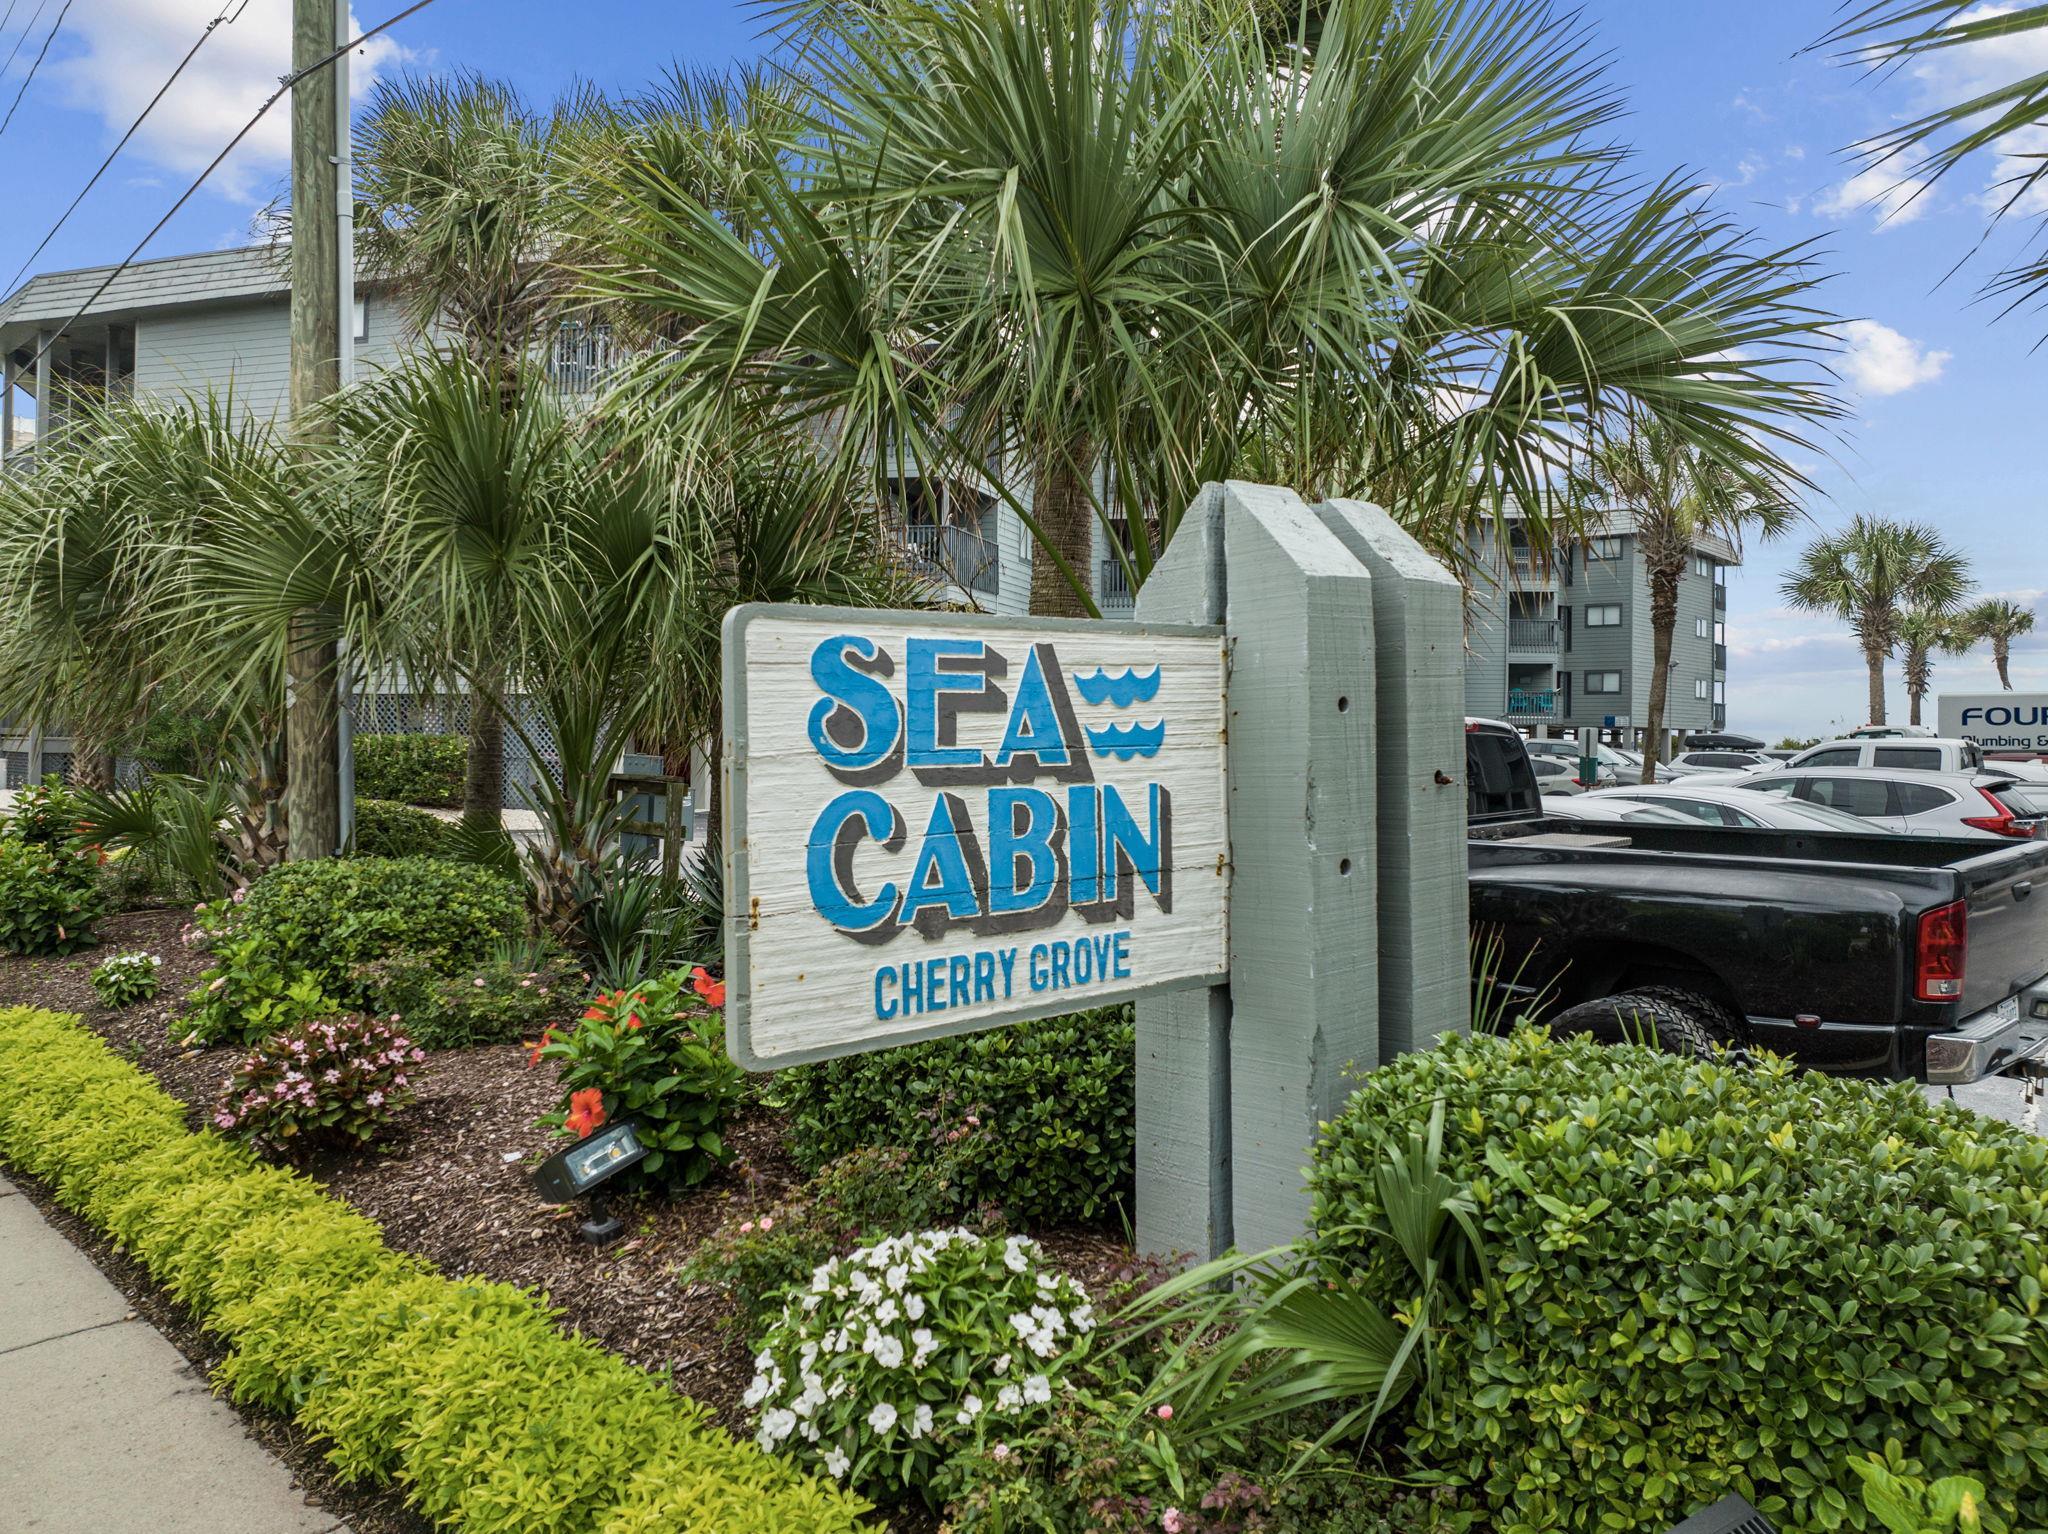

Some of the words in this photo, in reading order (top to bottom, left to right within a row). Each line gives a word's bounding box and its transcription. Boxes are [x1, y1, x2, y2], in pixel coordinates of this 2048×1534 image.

[807, 634, 1072, 772] SEA
[1962, 706, 2048, 726] FOU
[806, 782, 1164, 931] CABIN
[874, 947, 1018, 1021] CHERRY
[1029, 931, 1132, 993] GROVE
